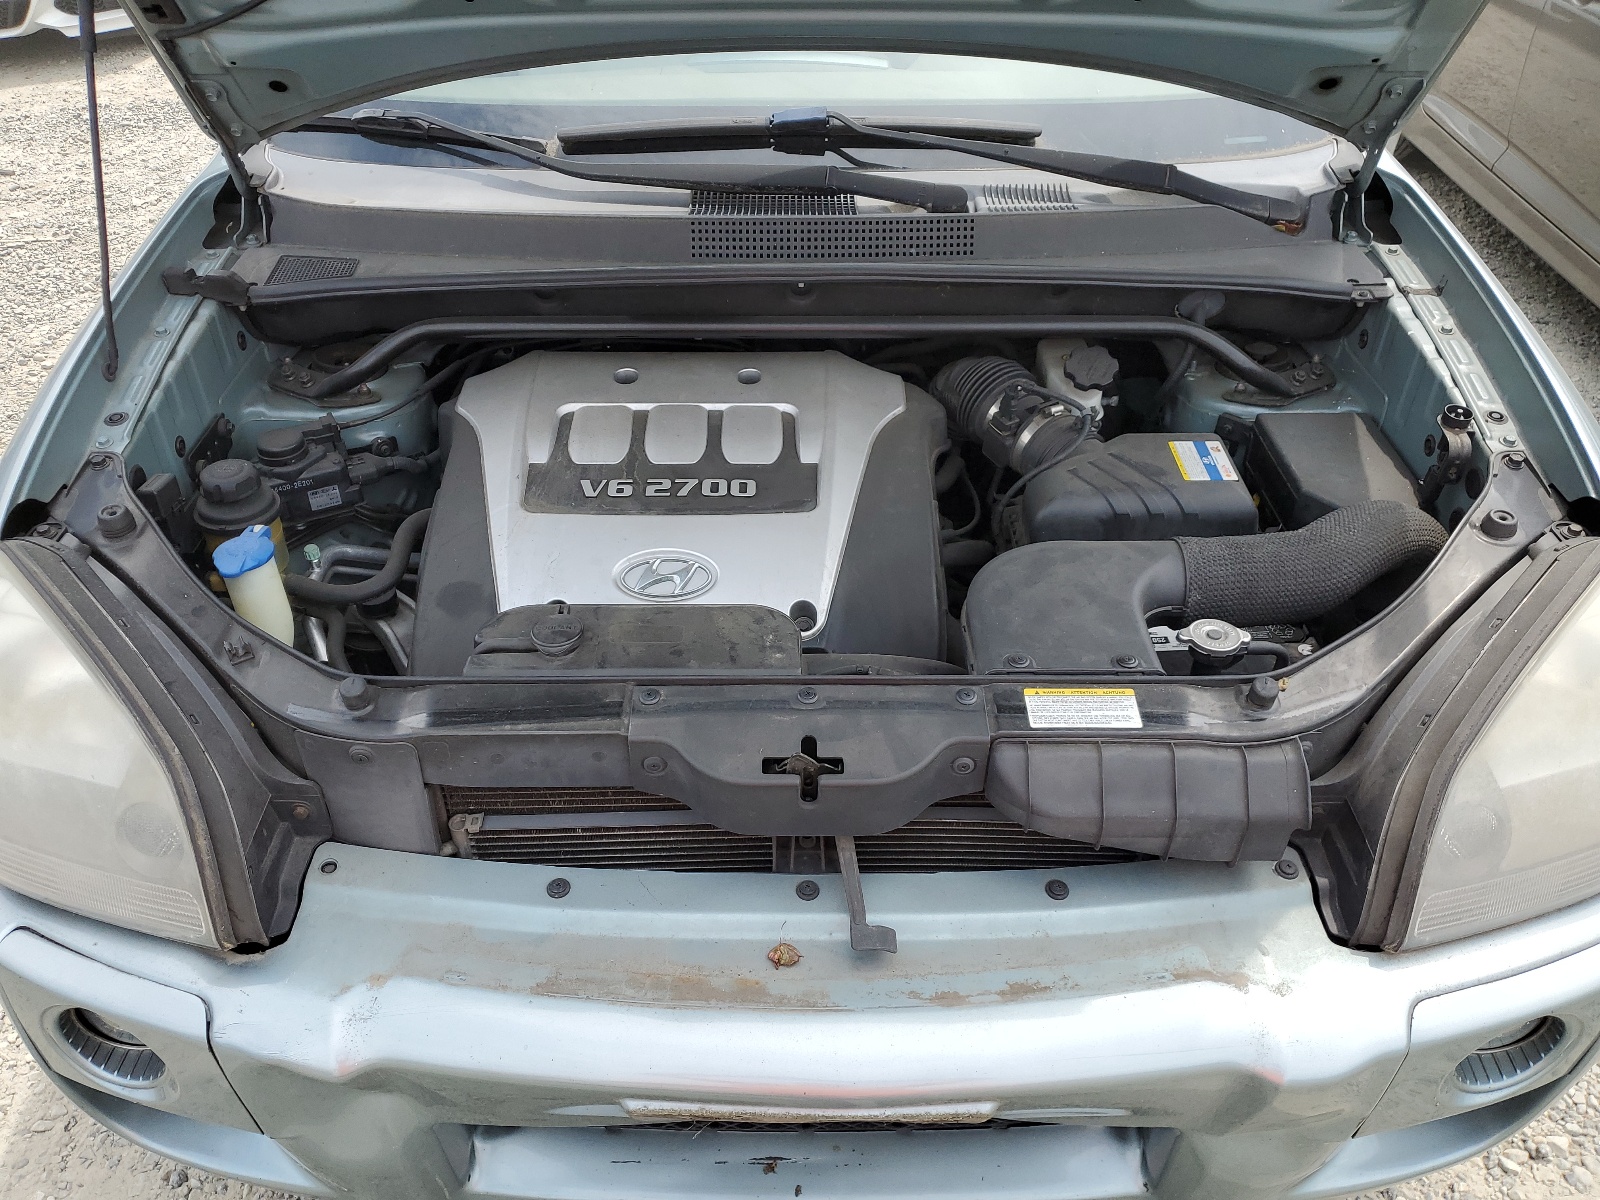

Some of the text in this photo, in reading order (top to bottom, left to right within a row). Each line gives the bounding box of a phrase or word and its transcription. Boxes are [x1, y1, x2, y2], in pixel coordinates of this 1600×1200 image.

[271, 479, 314, 493] 6400-2E201
[580, 478, 757, 498] V6 2700
